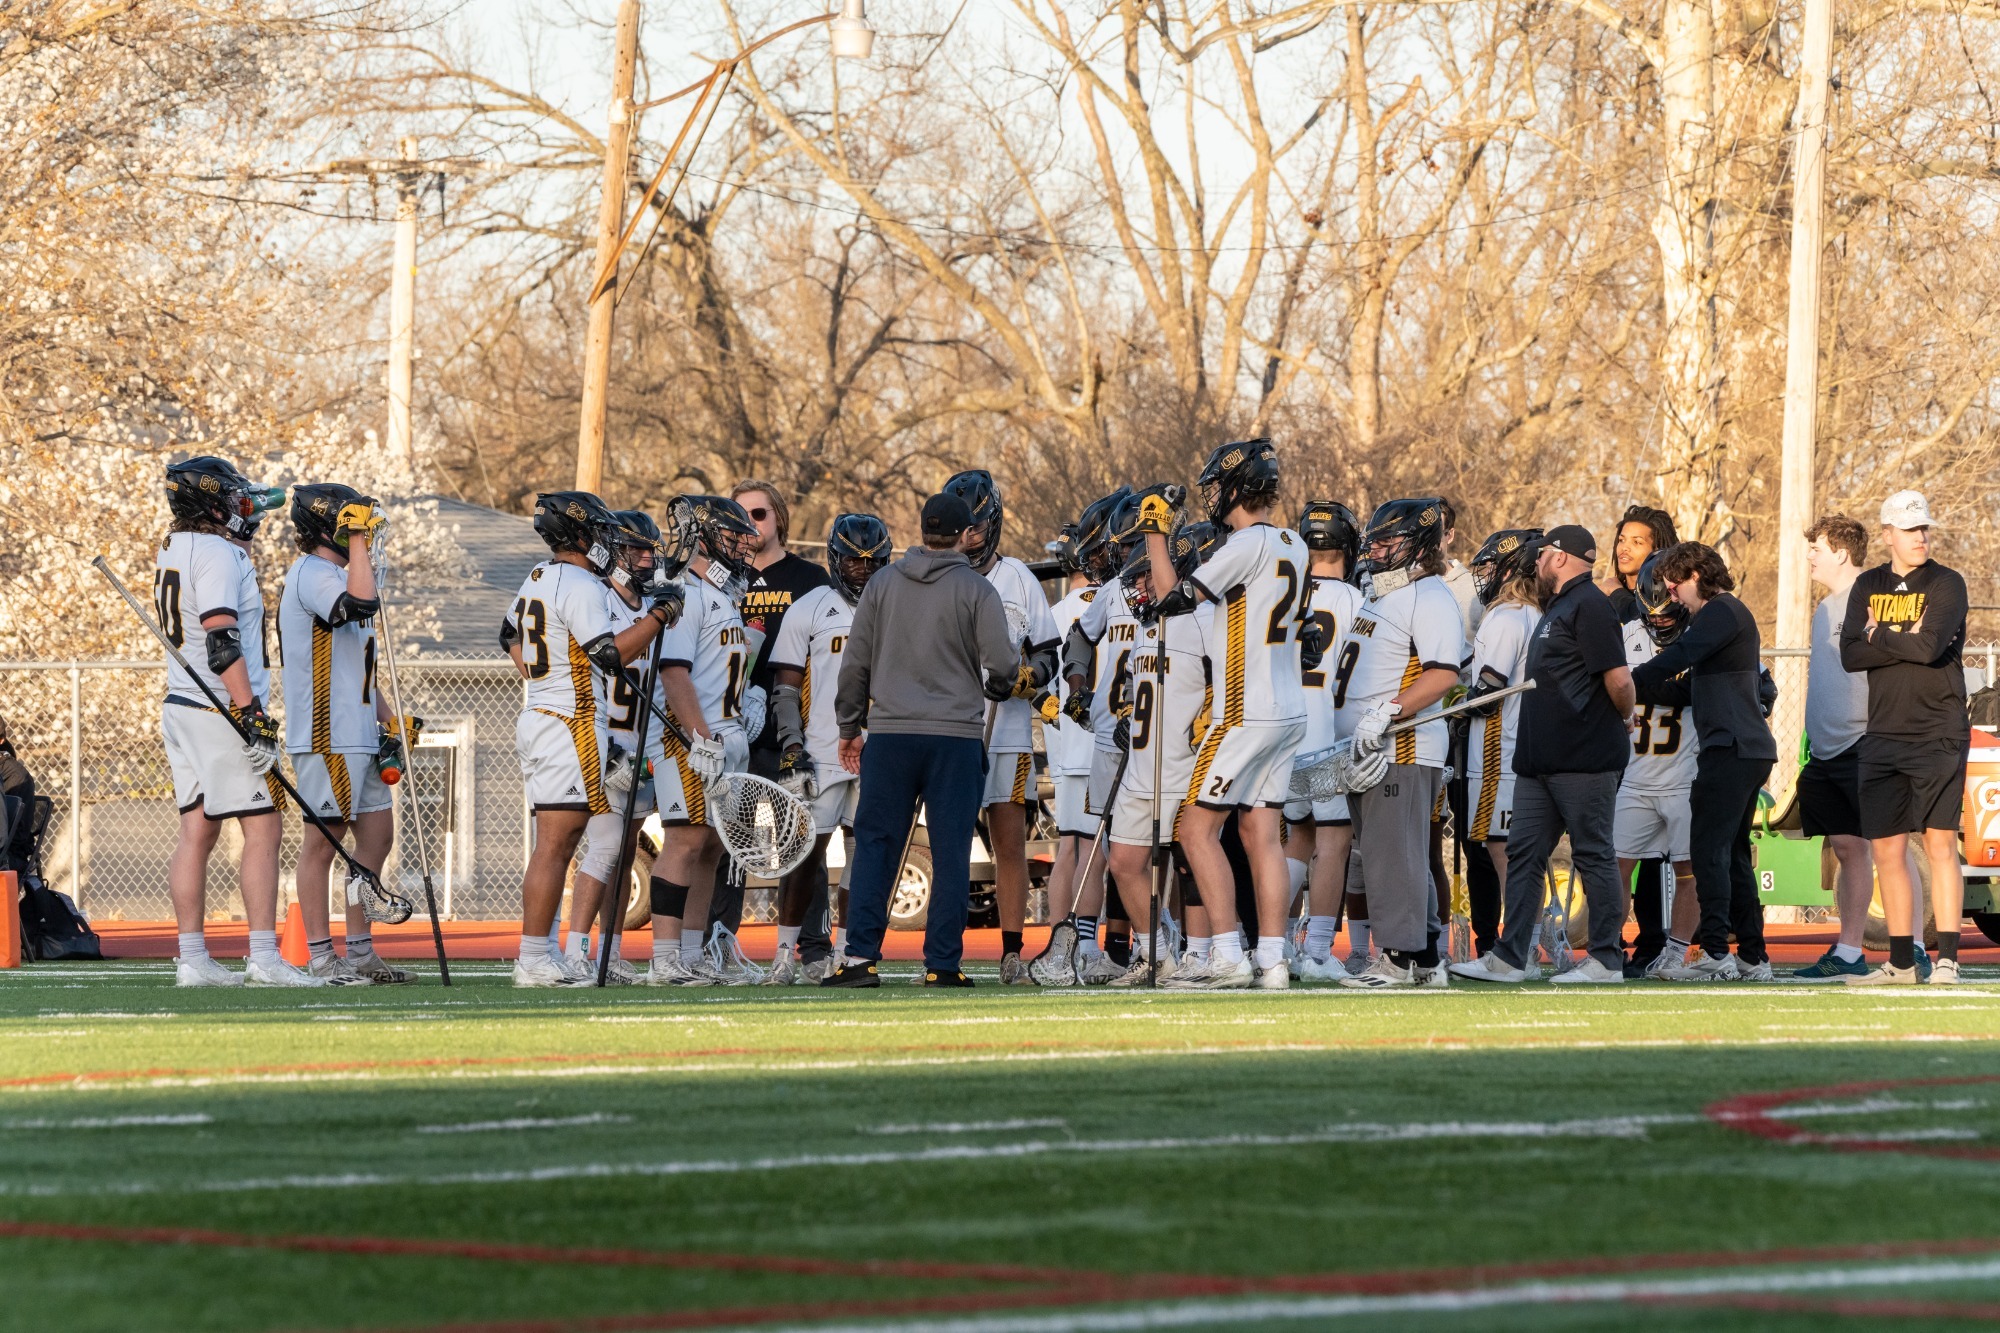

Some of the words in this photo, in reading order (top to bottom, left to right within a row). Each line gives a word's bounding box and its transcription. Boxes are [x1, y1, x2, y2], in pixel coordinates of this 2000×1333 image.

[200, 474, 220, 493] 60
[566, 502, 588, 522] 23
[738, 591, 793, 606] TAWA
[1869, 593, 1917, 622] OTTAWA
[743, 606, 784, 614] CROSSE
[1108, 624, 1139, 643] OTTA
[1350, 616, 1377, 638] TAWA
[362, 635, 378, 705] 1
[1333, 640, 1361, 710] 9
[1132, 679, 1154, 750] 9
[1209, 775, 1234, 798] 24
[1384, 783, 1400, 797] 90
[1762, 872, 1773, 890] 3
